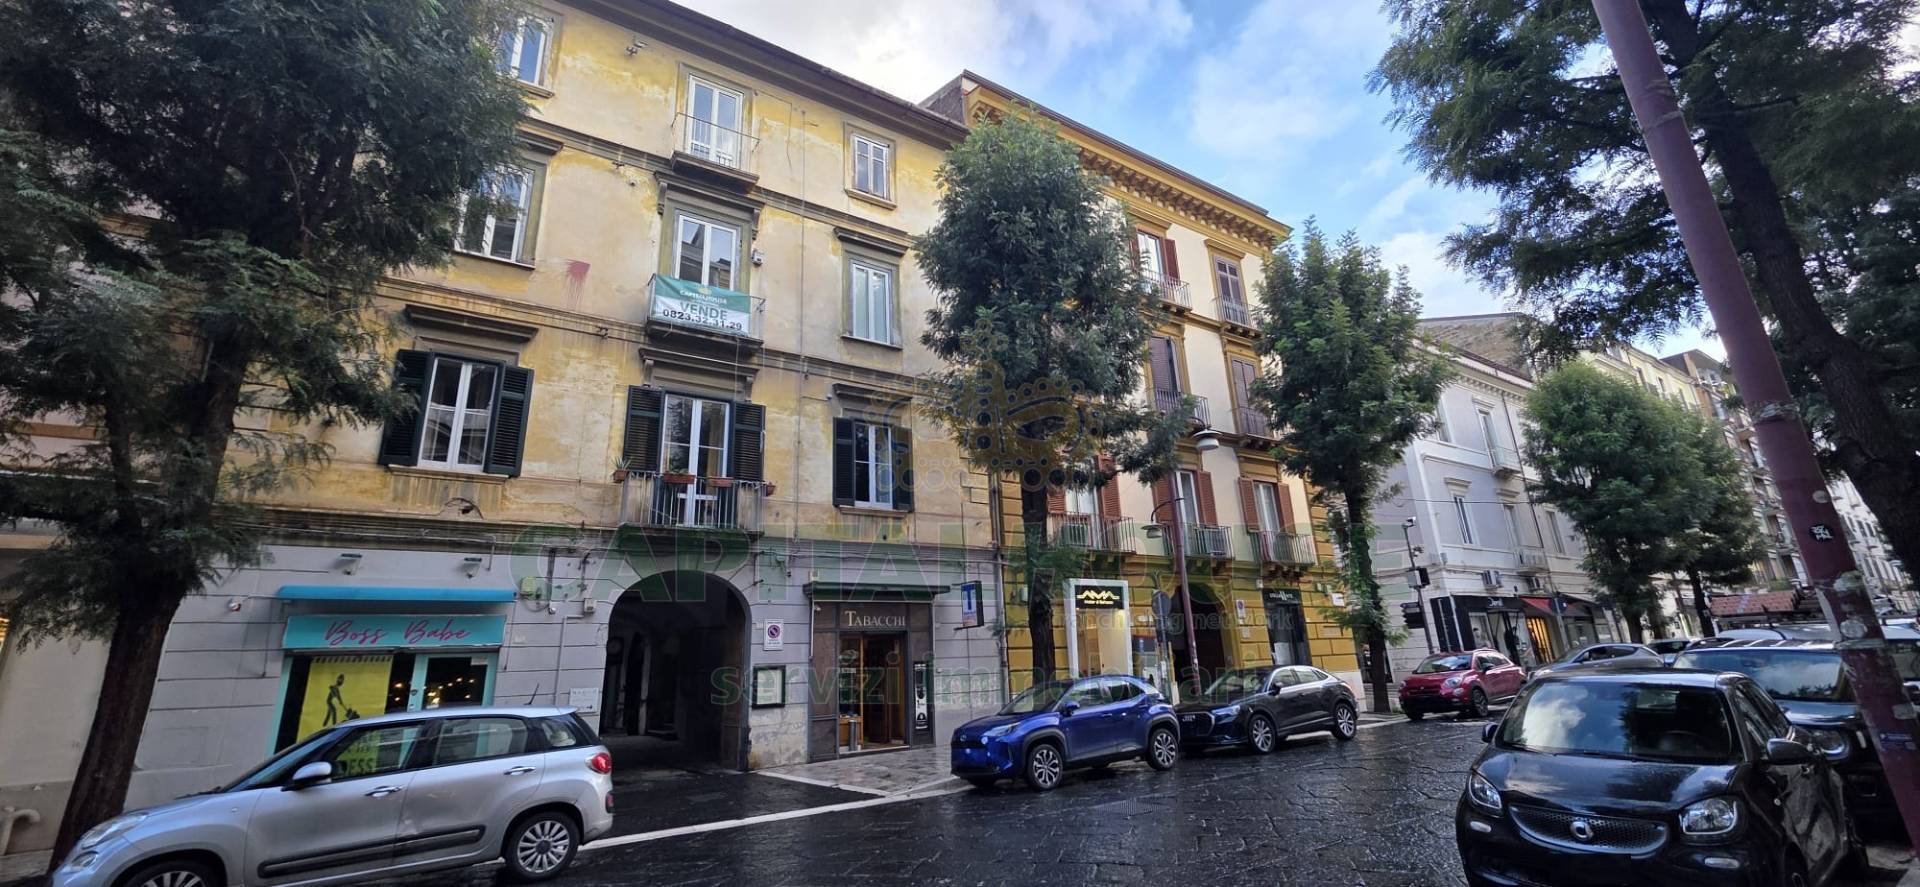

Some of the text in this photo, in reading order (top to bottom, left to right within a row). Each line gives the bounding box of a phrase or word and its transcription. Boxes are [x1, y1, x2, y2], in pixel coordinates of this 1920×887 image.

[663, 308, 743, 331] 0823.32.31.29
[680, 302, 728, 320] VENDE
[844, 610, 906, 627] TABACCHI
[325, 618, 471, 646] Boss Babe
